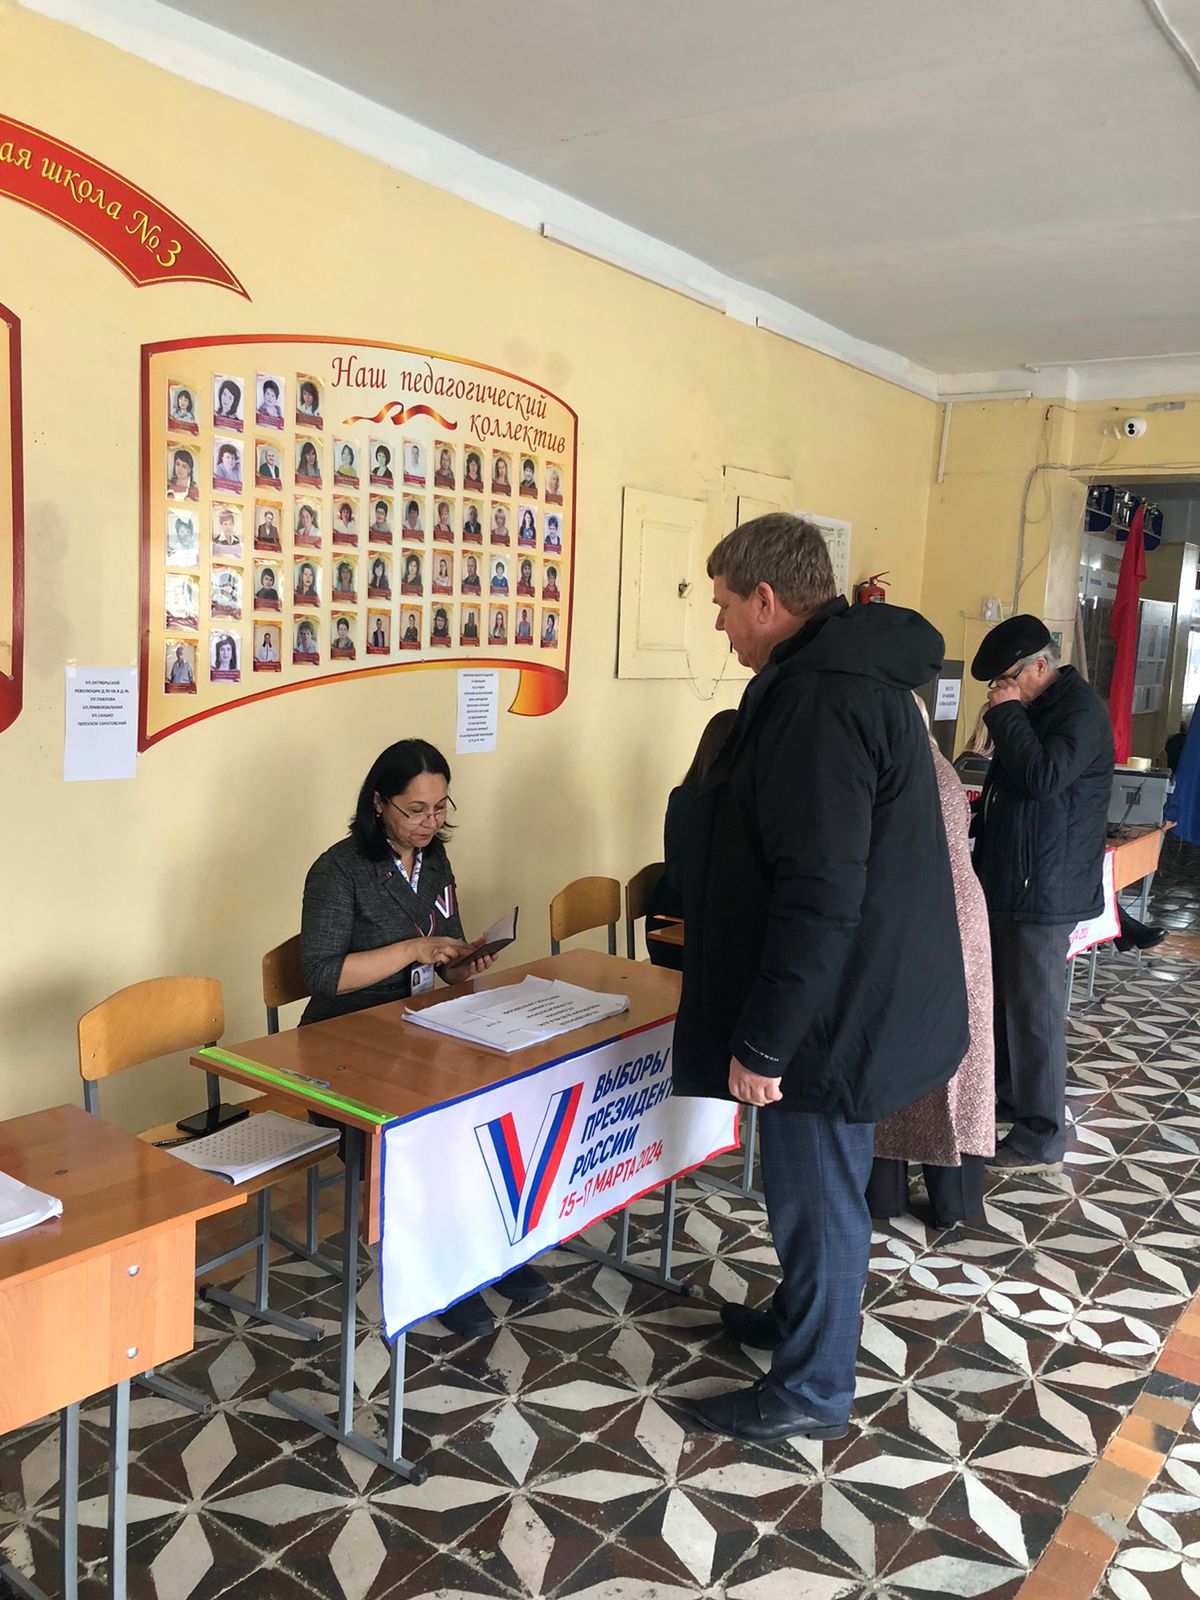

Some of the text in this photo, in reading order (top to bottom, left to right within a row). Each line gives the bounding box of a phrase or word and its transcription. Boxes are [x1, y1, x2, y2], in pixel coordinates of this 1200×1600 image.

[41, 158, 123, 220] школа
[331, 355, 548, 421] Наш педагогический
[469, 414, 566, 453] коллектив
[592, 1047, 671, 1104] ВЫБОРЫ
[581, 1076, 673, 1144] ПРЕЗИДЕНТ
[568, 1123, 641, 1185] РОССИИ
[592, 1156, 636, 1197] МАРТА
[635, 1139, 663, 1174] 2024
